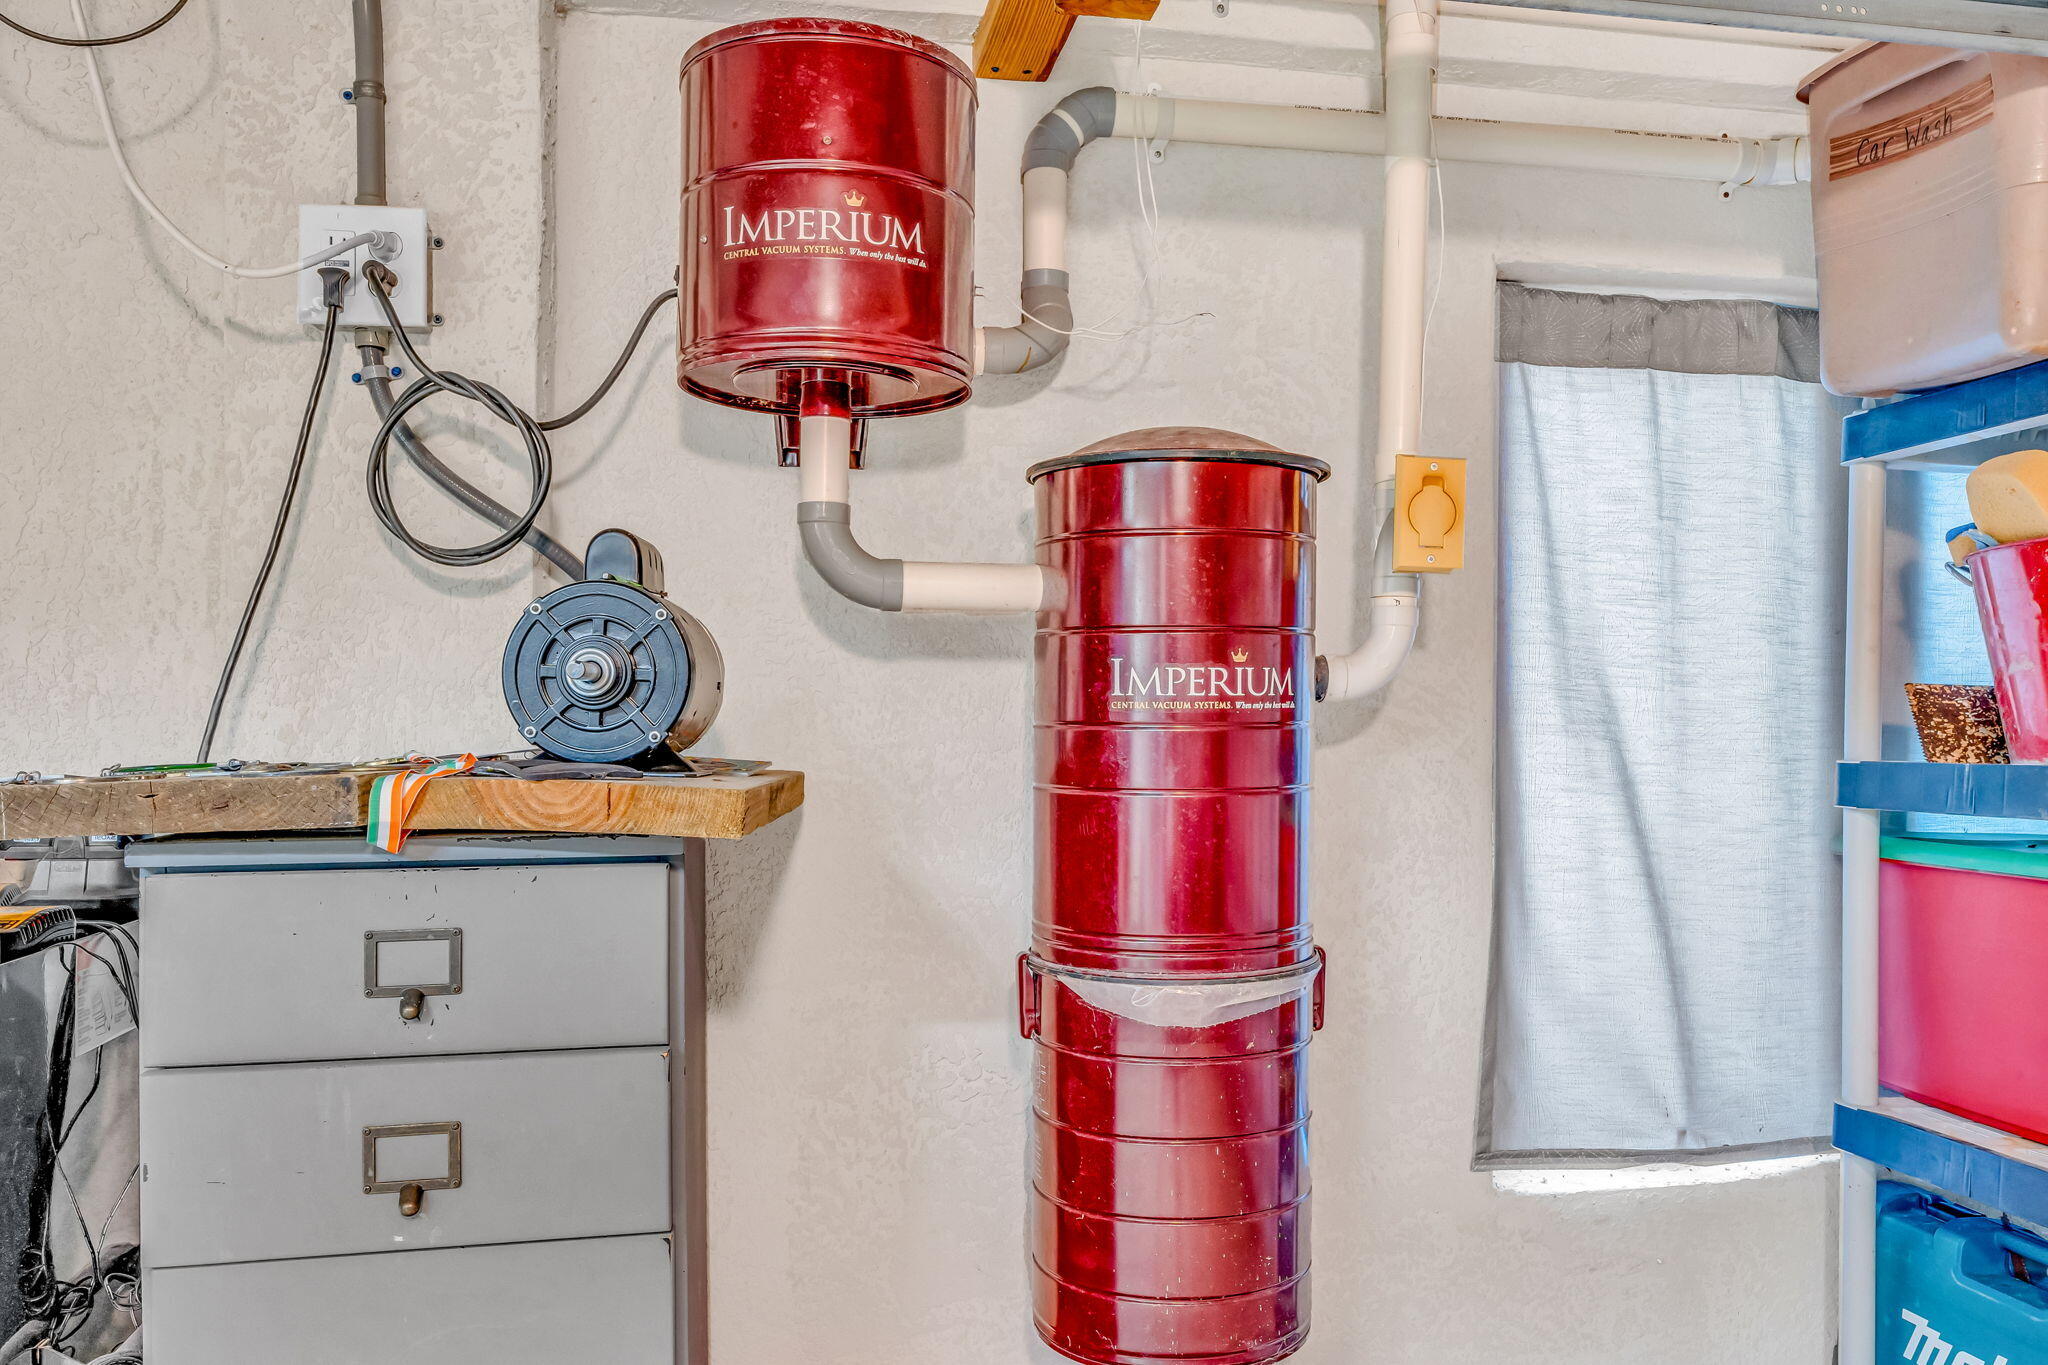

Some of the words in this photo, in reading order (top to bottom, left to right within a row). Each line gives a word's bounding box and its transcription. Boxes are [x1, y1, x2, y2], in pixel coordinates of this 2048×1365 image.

[1856, 136, 1896, 167] Car
[1904, 106, 1953, 151] Wash
[723, 205, 925, 255] IMPERIUM
[723, 247, 760, 260] CENTRAL
[761, 245, 801, 255] VACUUM
[803, 245, 847, 255] SYSTEMS.
[849, 247, 869, 257] When
[869, 250, 884, 261] only
[884, 252, 895, 261] the
[894, 253, 907, 263] best
[1110, 657, 1294, 697] IMPERIUM
[1111, 701, 1151, 709] CENTRAL
[1152, 701, 1192, 709] VACUUM
[1193, 701, 1234, 709] SYSTEMS.
